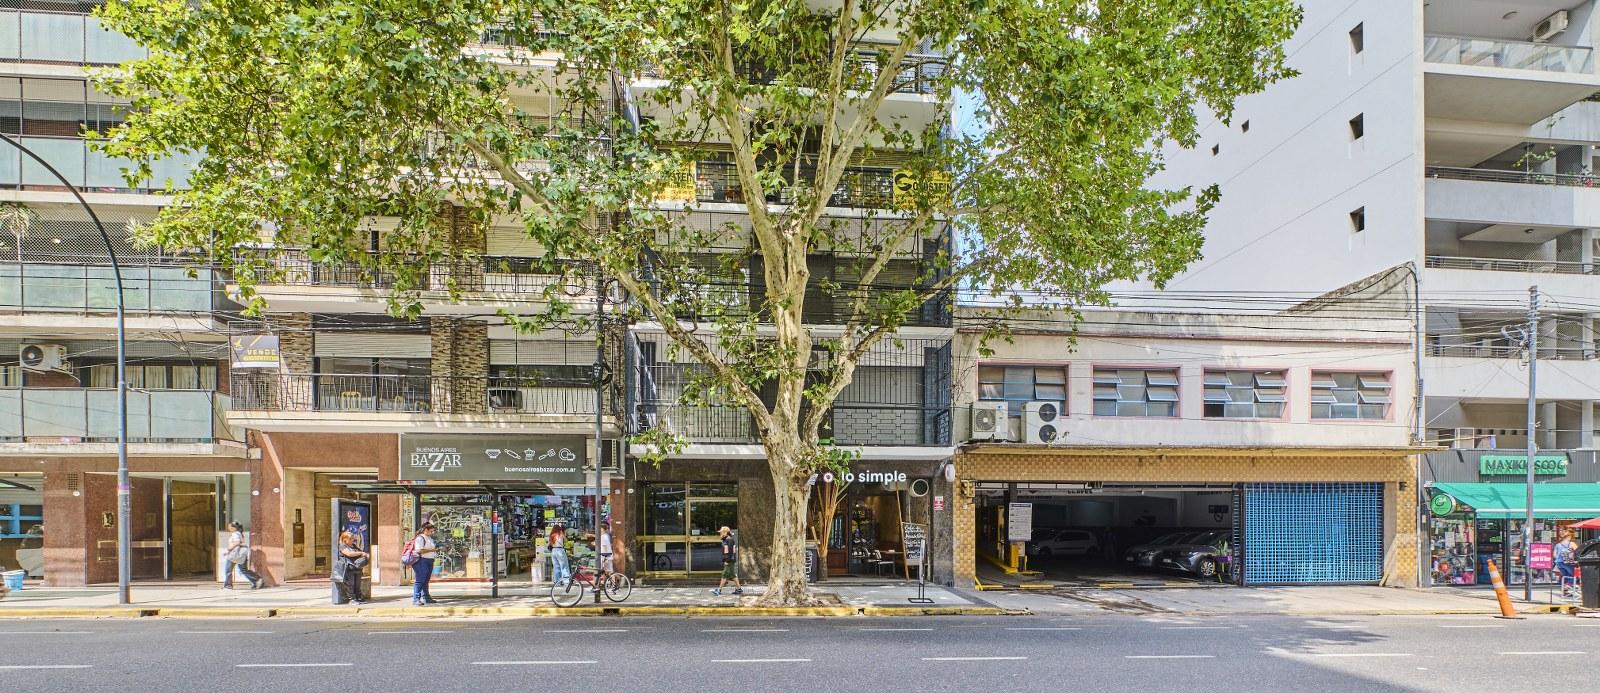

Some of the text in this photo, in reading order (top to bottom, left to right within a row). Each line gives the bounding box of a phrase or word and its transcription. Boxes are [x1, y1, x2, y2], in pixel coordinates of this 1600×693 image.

[410, 452, 462, 472] BAZAR
[841, 470, 855, 483] lo
[858, 469, 907, 485] simple
